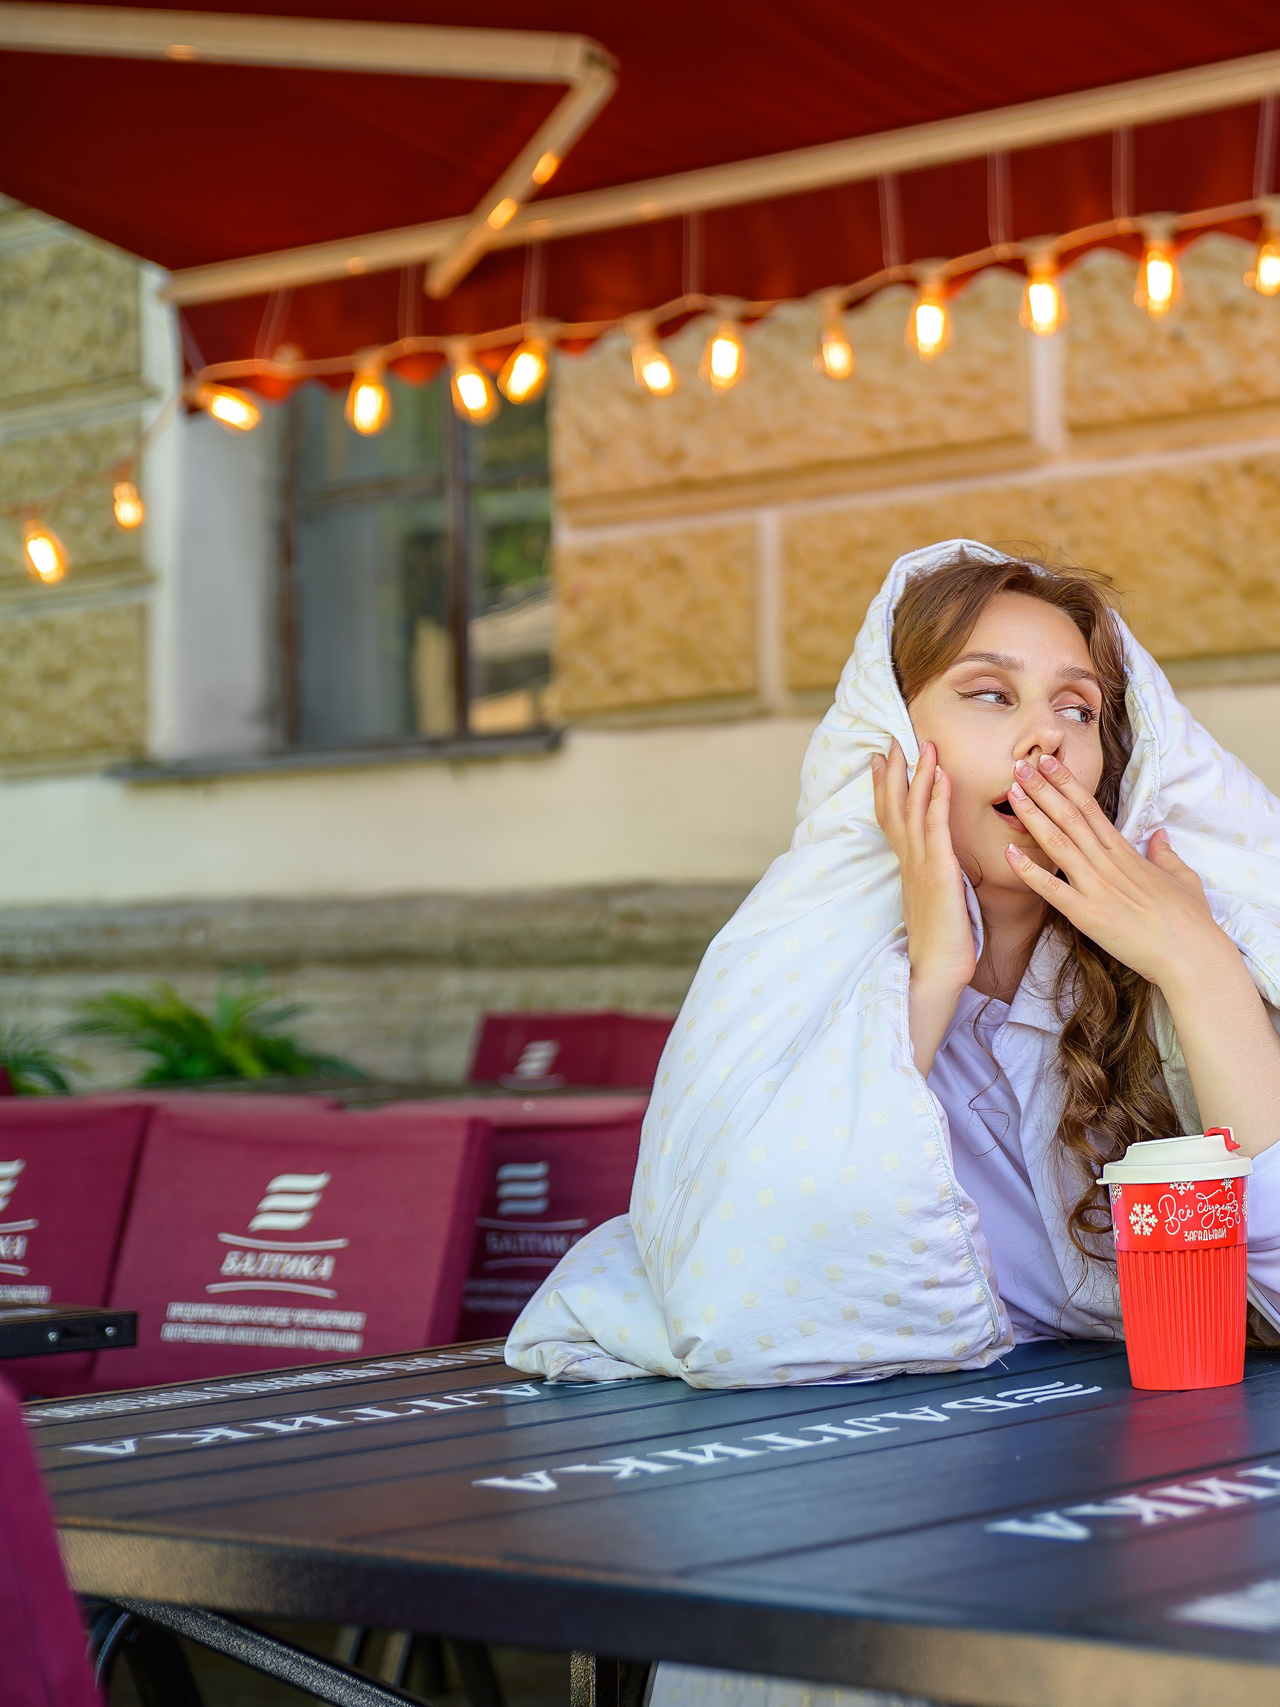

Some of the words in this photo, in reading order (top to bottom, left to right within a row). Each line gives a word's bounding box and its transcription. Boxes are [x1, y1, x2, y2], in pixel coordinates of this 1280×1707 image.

[1183, 1226, 1227, 1242] ЗАГАДЫВАЙ
[220, 1250, 336, 1281] БАЛТИКА
[471, 1396, 1035, 1493] БАЛТИКА
